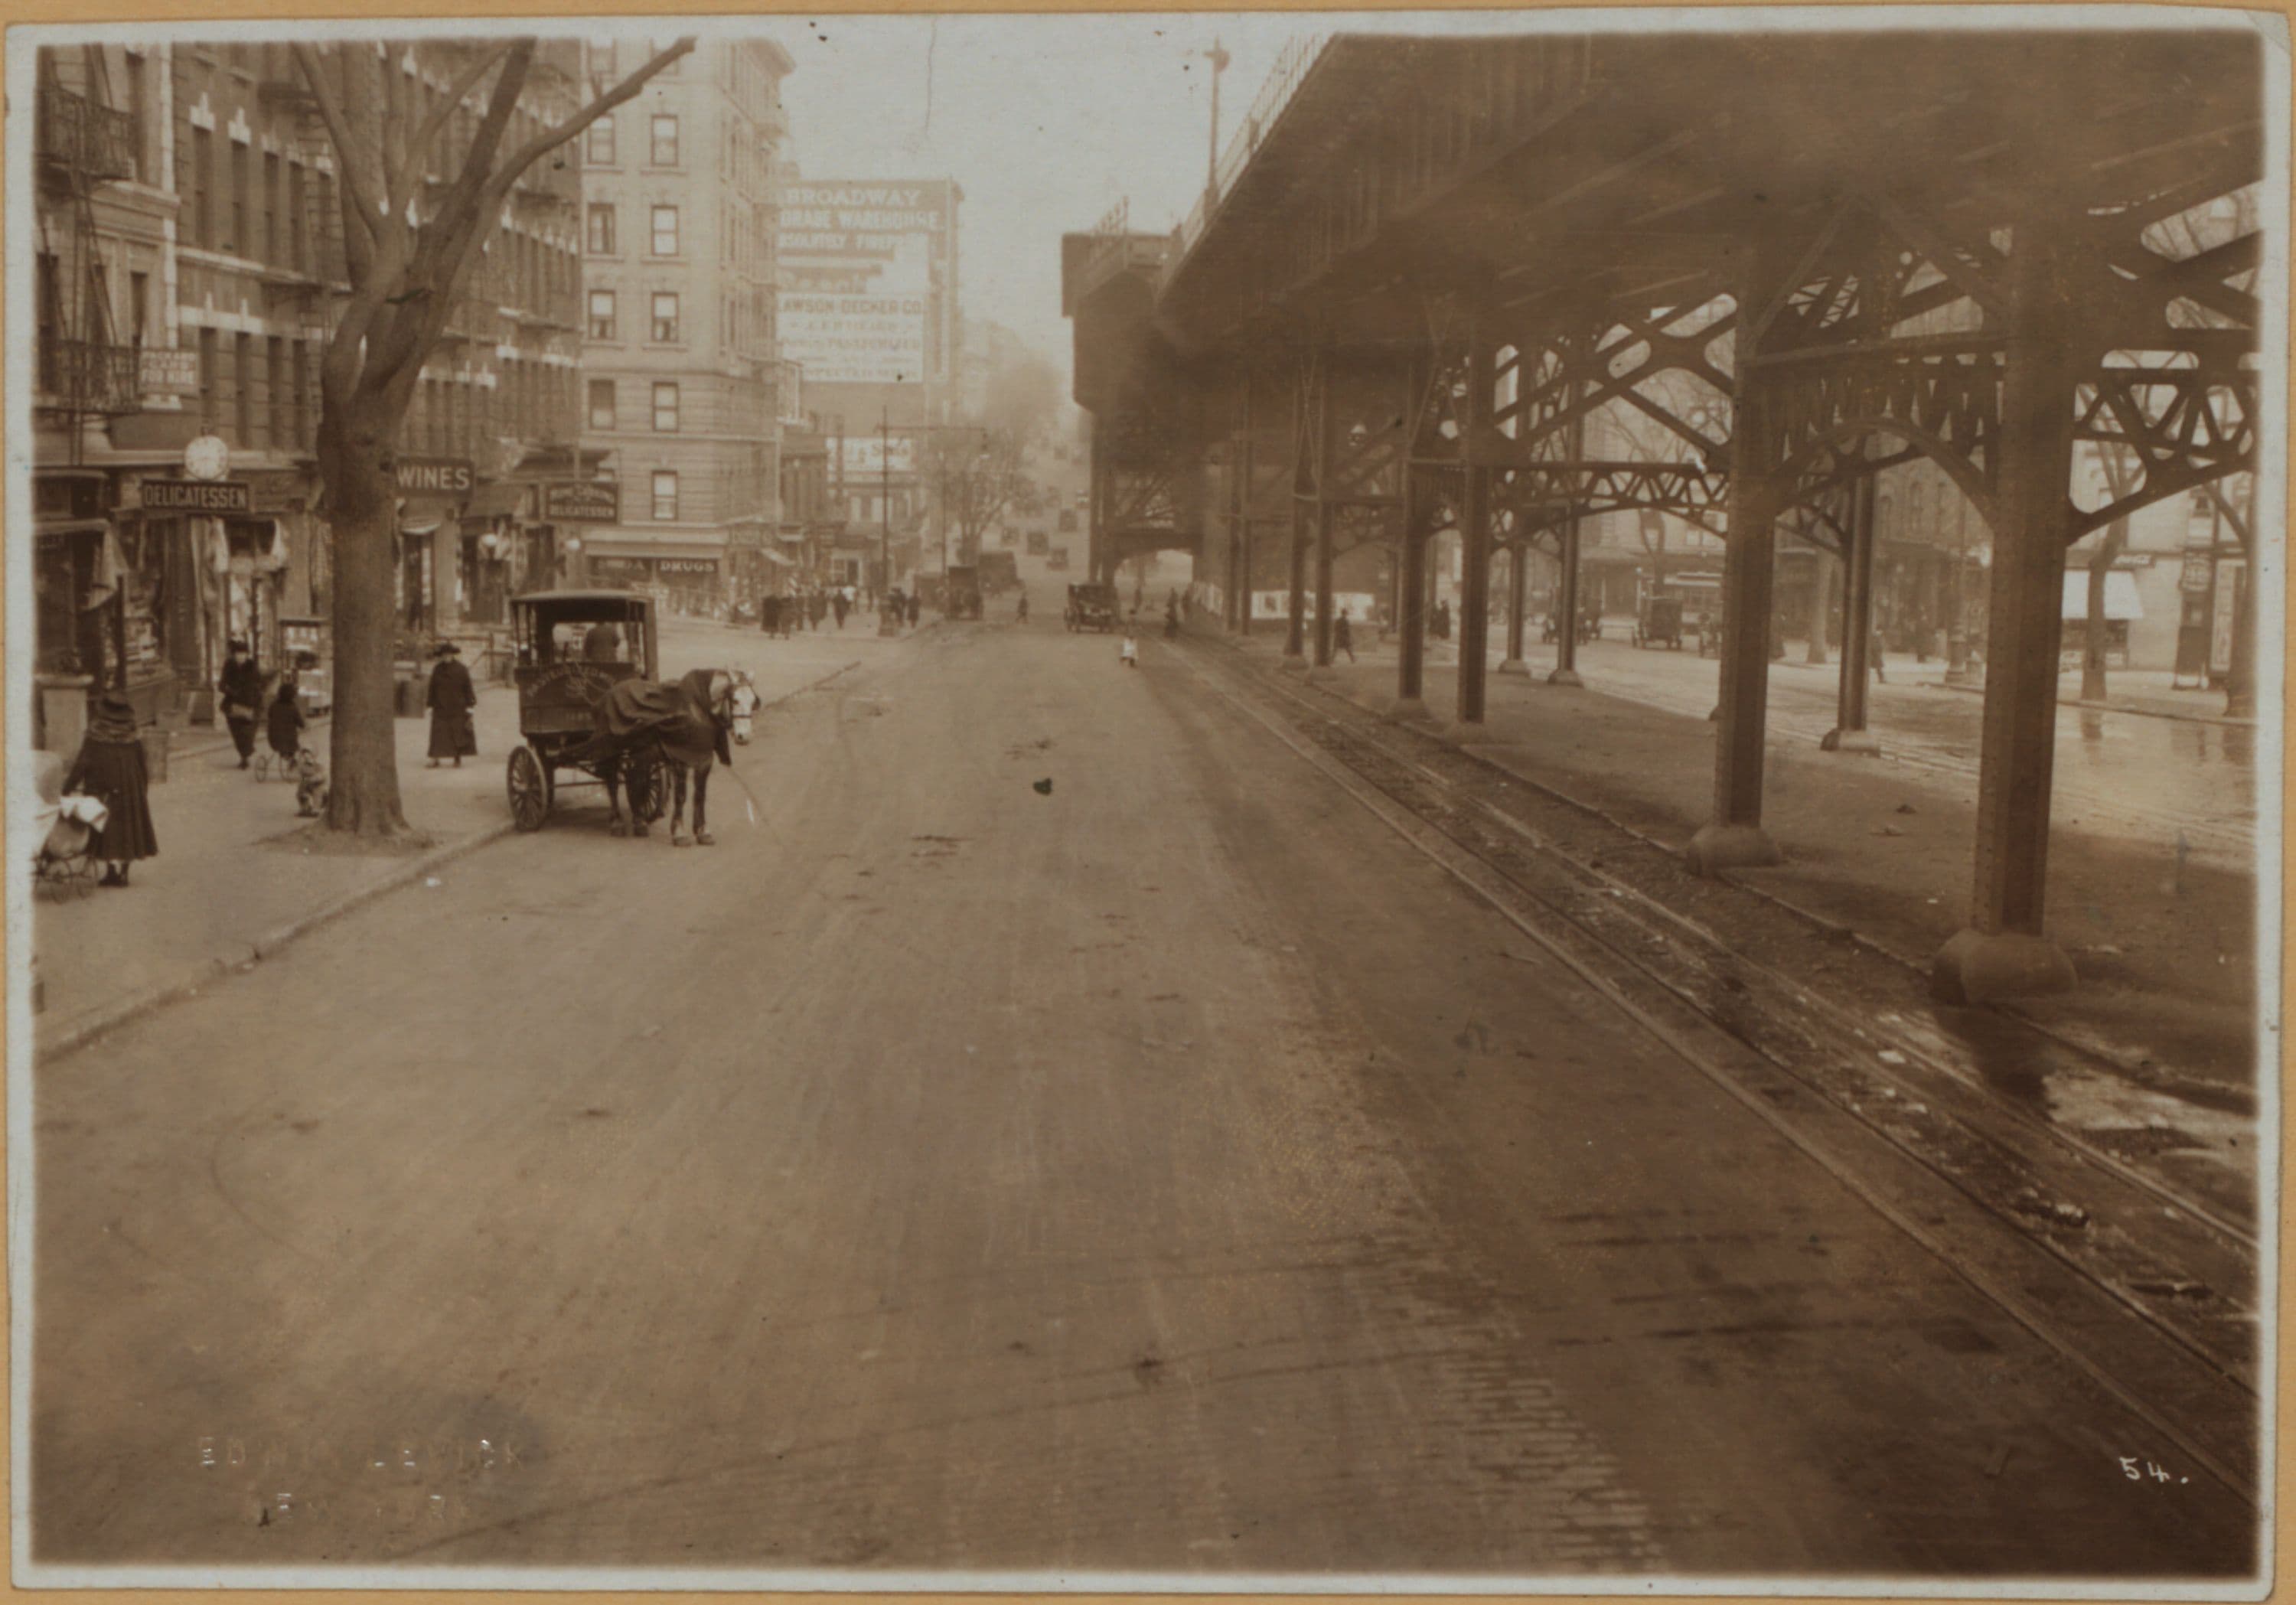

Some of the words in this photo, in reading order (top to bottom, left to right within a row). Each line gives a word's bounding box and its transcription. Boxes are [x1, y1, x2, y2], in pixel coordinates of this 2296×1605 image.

[786, 188, 921, 207] BROADWAY
[841, 299, 899, 315] DECKER
[396, 465, 471, 491] WINES
[145, 484, 247, 507] DELICATESSEN
[660, 559, 715, 572] DRUGS
